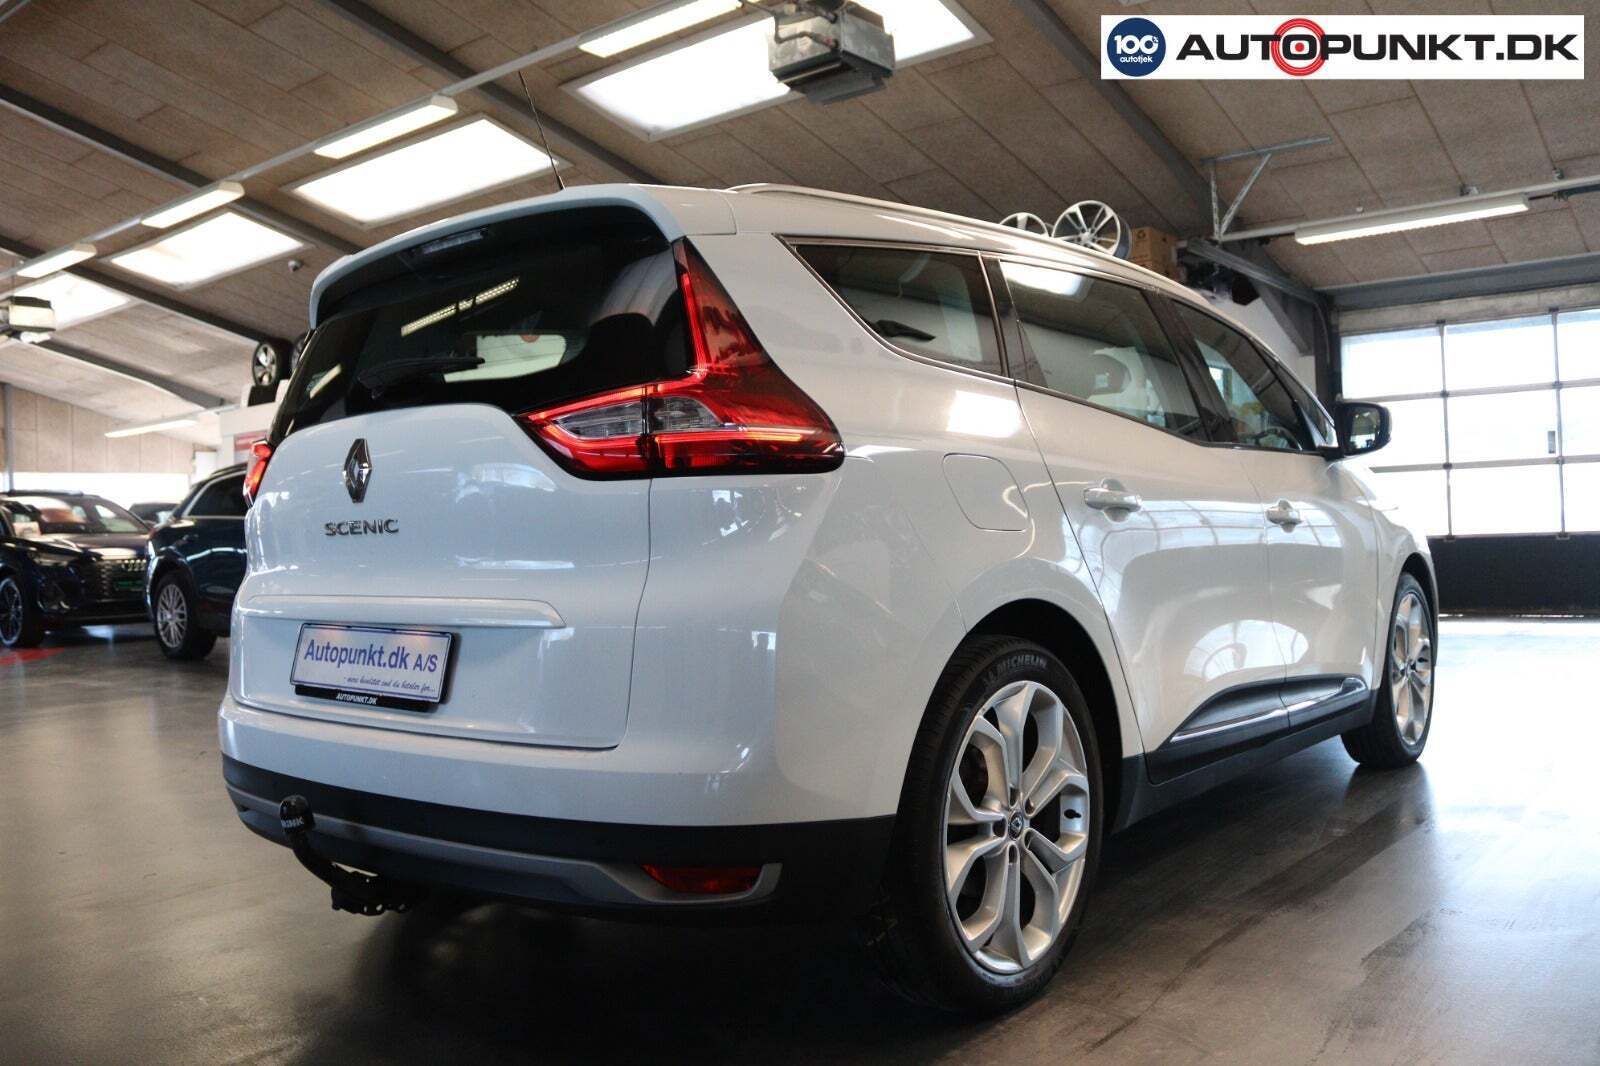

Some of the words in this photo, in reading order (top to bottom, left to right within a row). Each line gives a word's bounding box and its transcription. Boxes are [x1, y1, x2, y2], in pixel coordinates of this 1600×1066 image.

[324, 519, 399, 536] SCENIC
[304, 639, 410, 670] Autopunkt.dk
[413, 653, 438, 673] A/S
[997, 654, 1048, 675] MICHELIN
[336, 692, 378, 705] AUTOPUNKT.DK
